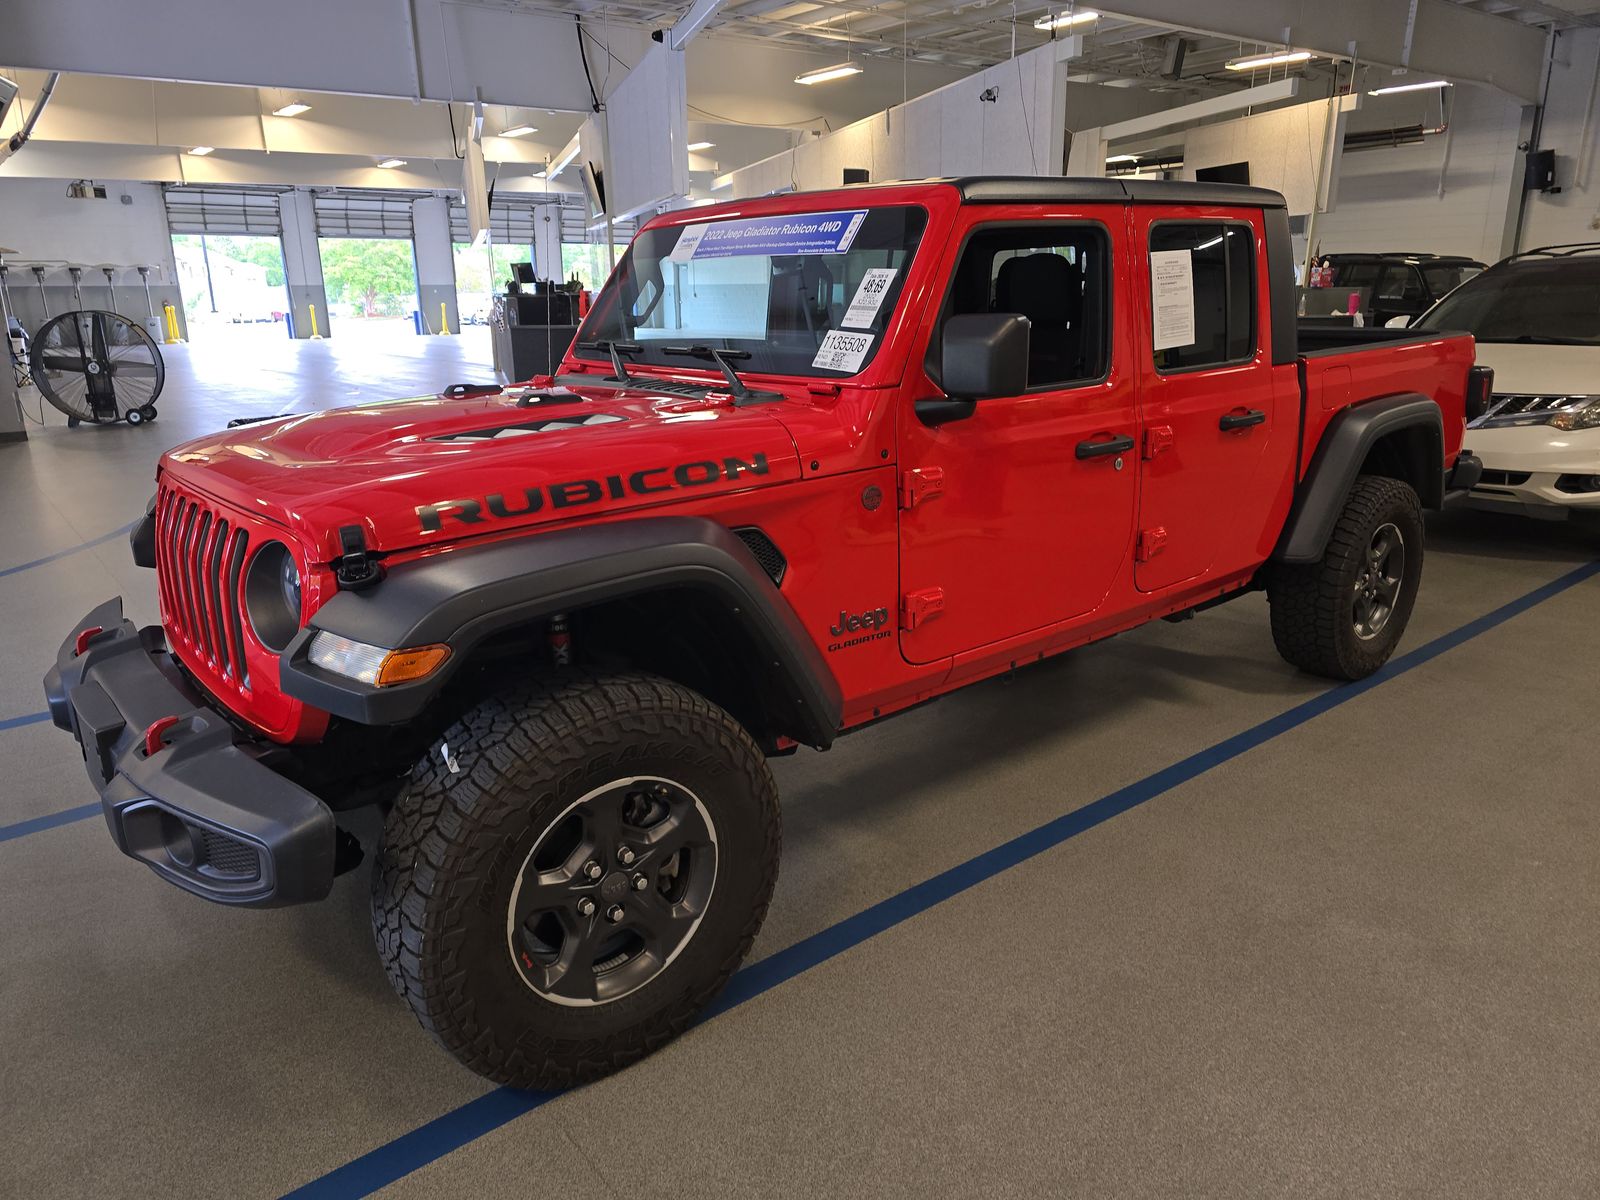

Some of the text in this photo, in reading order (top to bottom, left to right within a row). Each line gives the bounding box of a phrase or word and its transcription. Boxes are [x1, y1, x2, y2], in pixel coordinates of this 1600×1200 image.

[703, 220, 842, 241] 2022 Jeep Gladiator Rubicon 4WD
[823, 334, 867, 353] 1135508
[415, 452, 769, 536] RUBICON
[829, 607, 889, 637] Jeep
[827, 630, 892, 653] GLADIATOR
